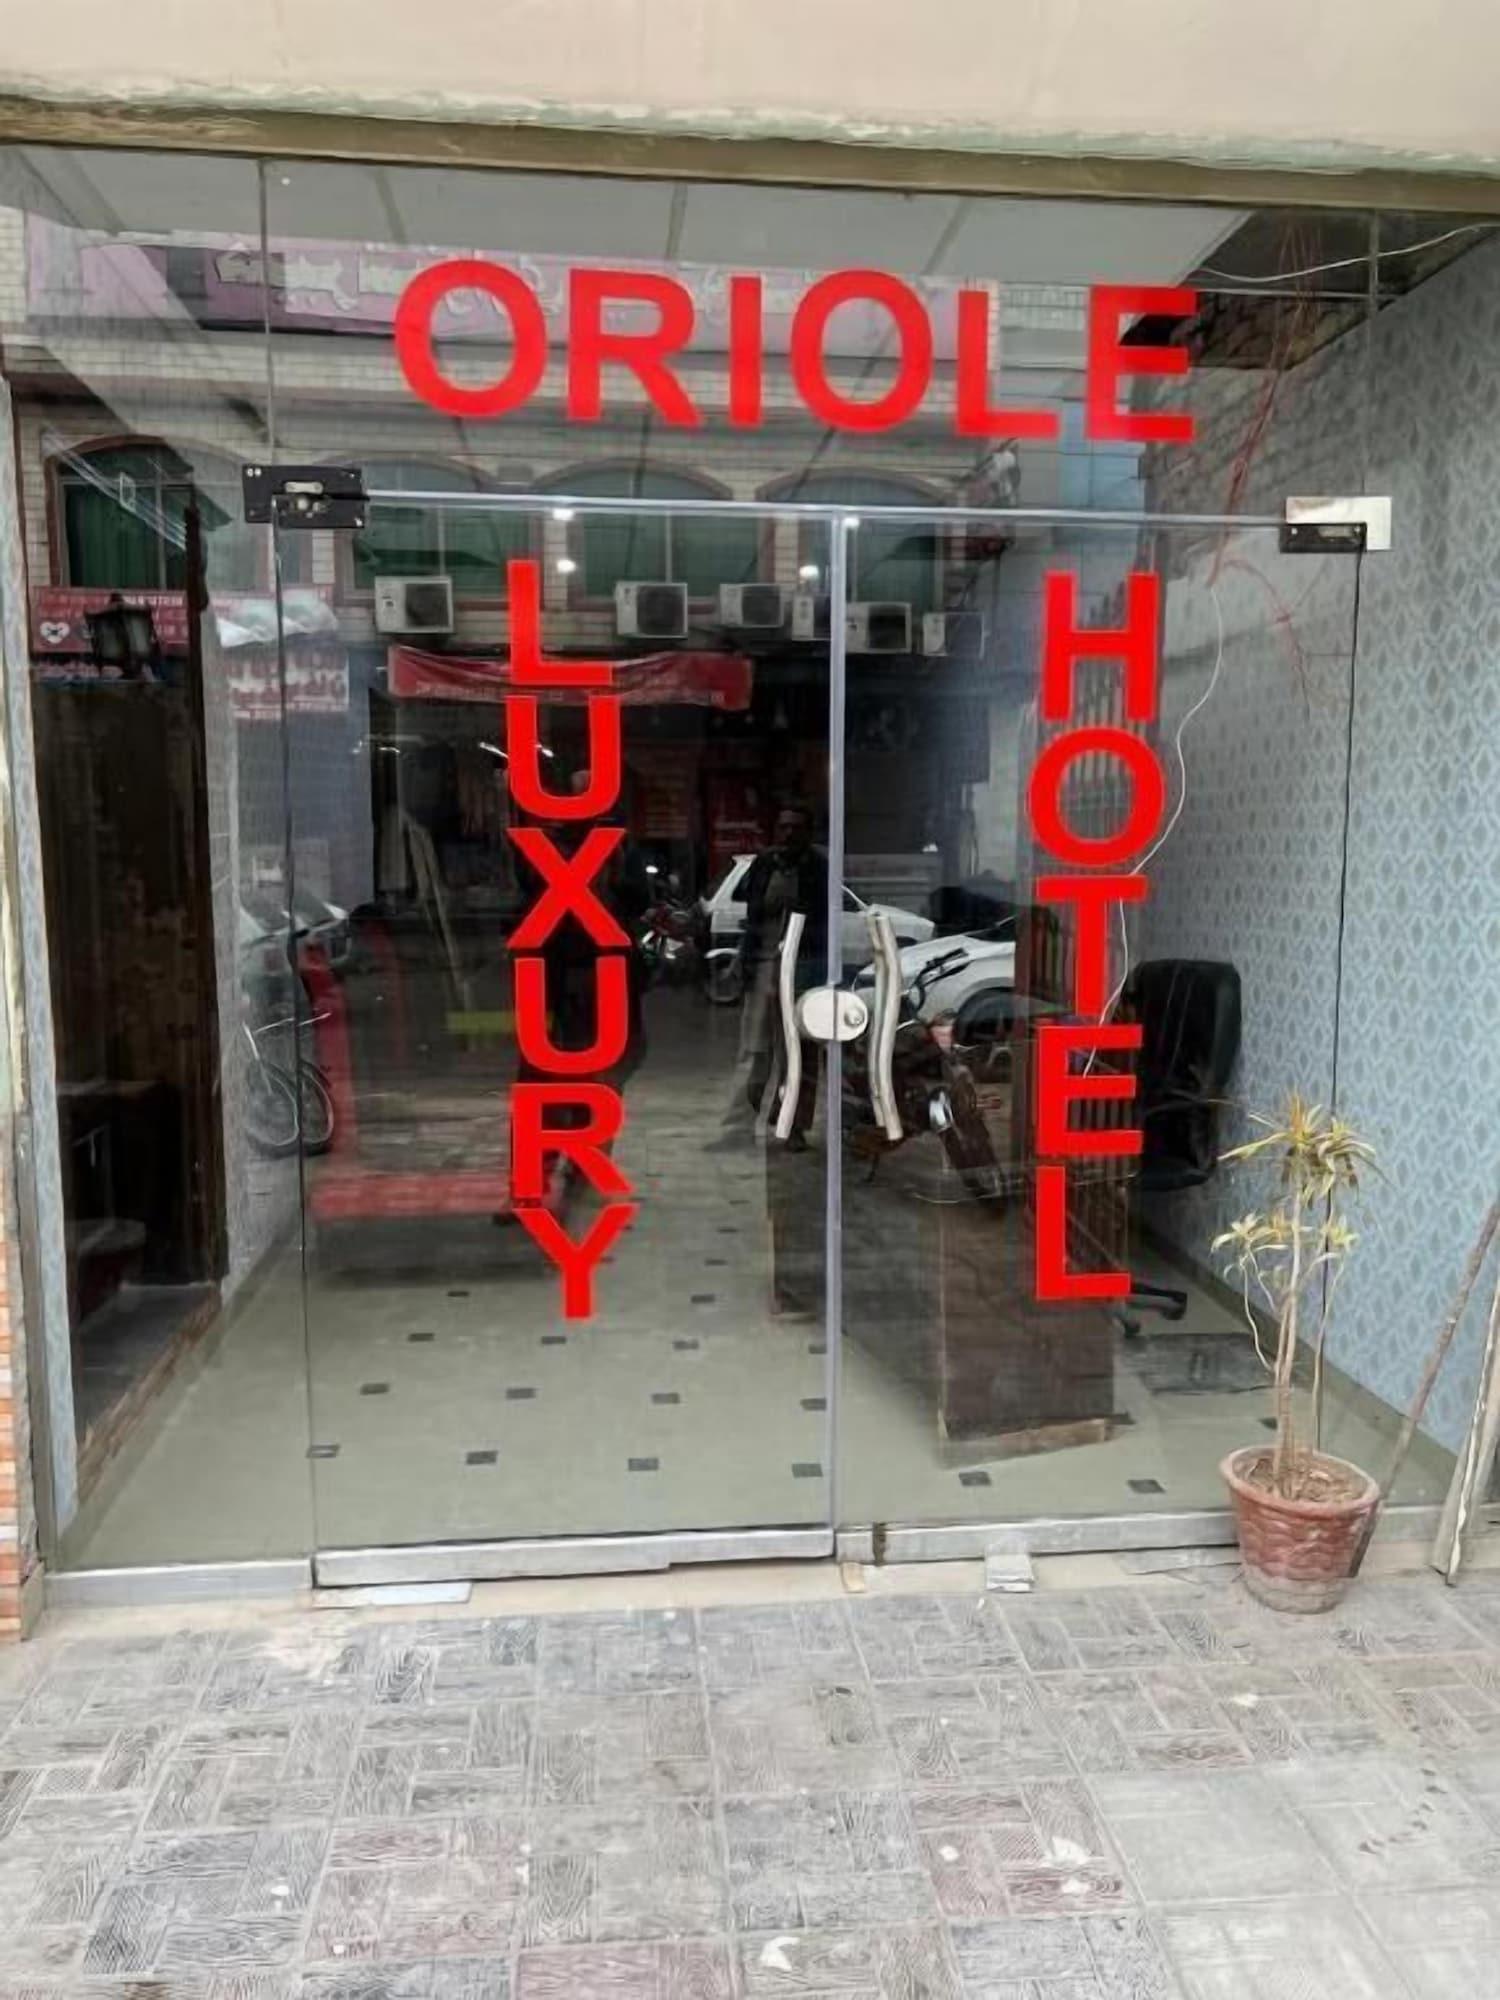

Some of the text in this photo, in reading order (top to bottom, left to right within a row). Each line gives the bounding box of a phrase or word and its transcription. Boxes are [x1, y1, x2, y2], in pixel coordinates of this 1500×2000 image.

[393, 259, 1197, 442] ORIOLE
[506, 558, 634, 1320] LUXURY
[1028, 571, 1166, 1301] HOTEL
